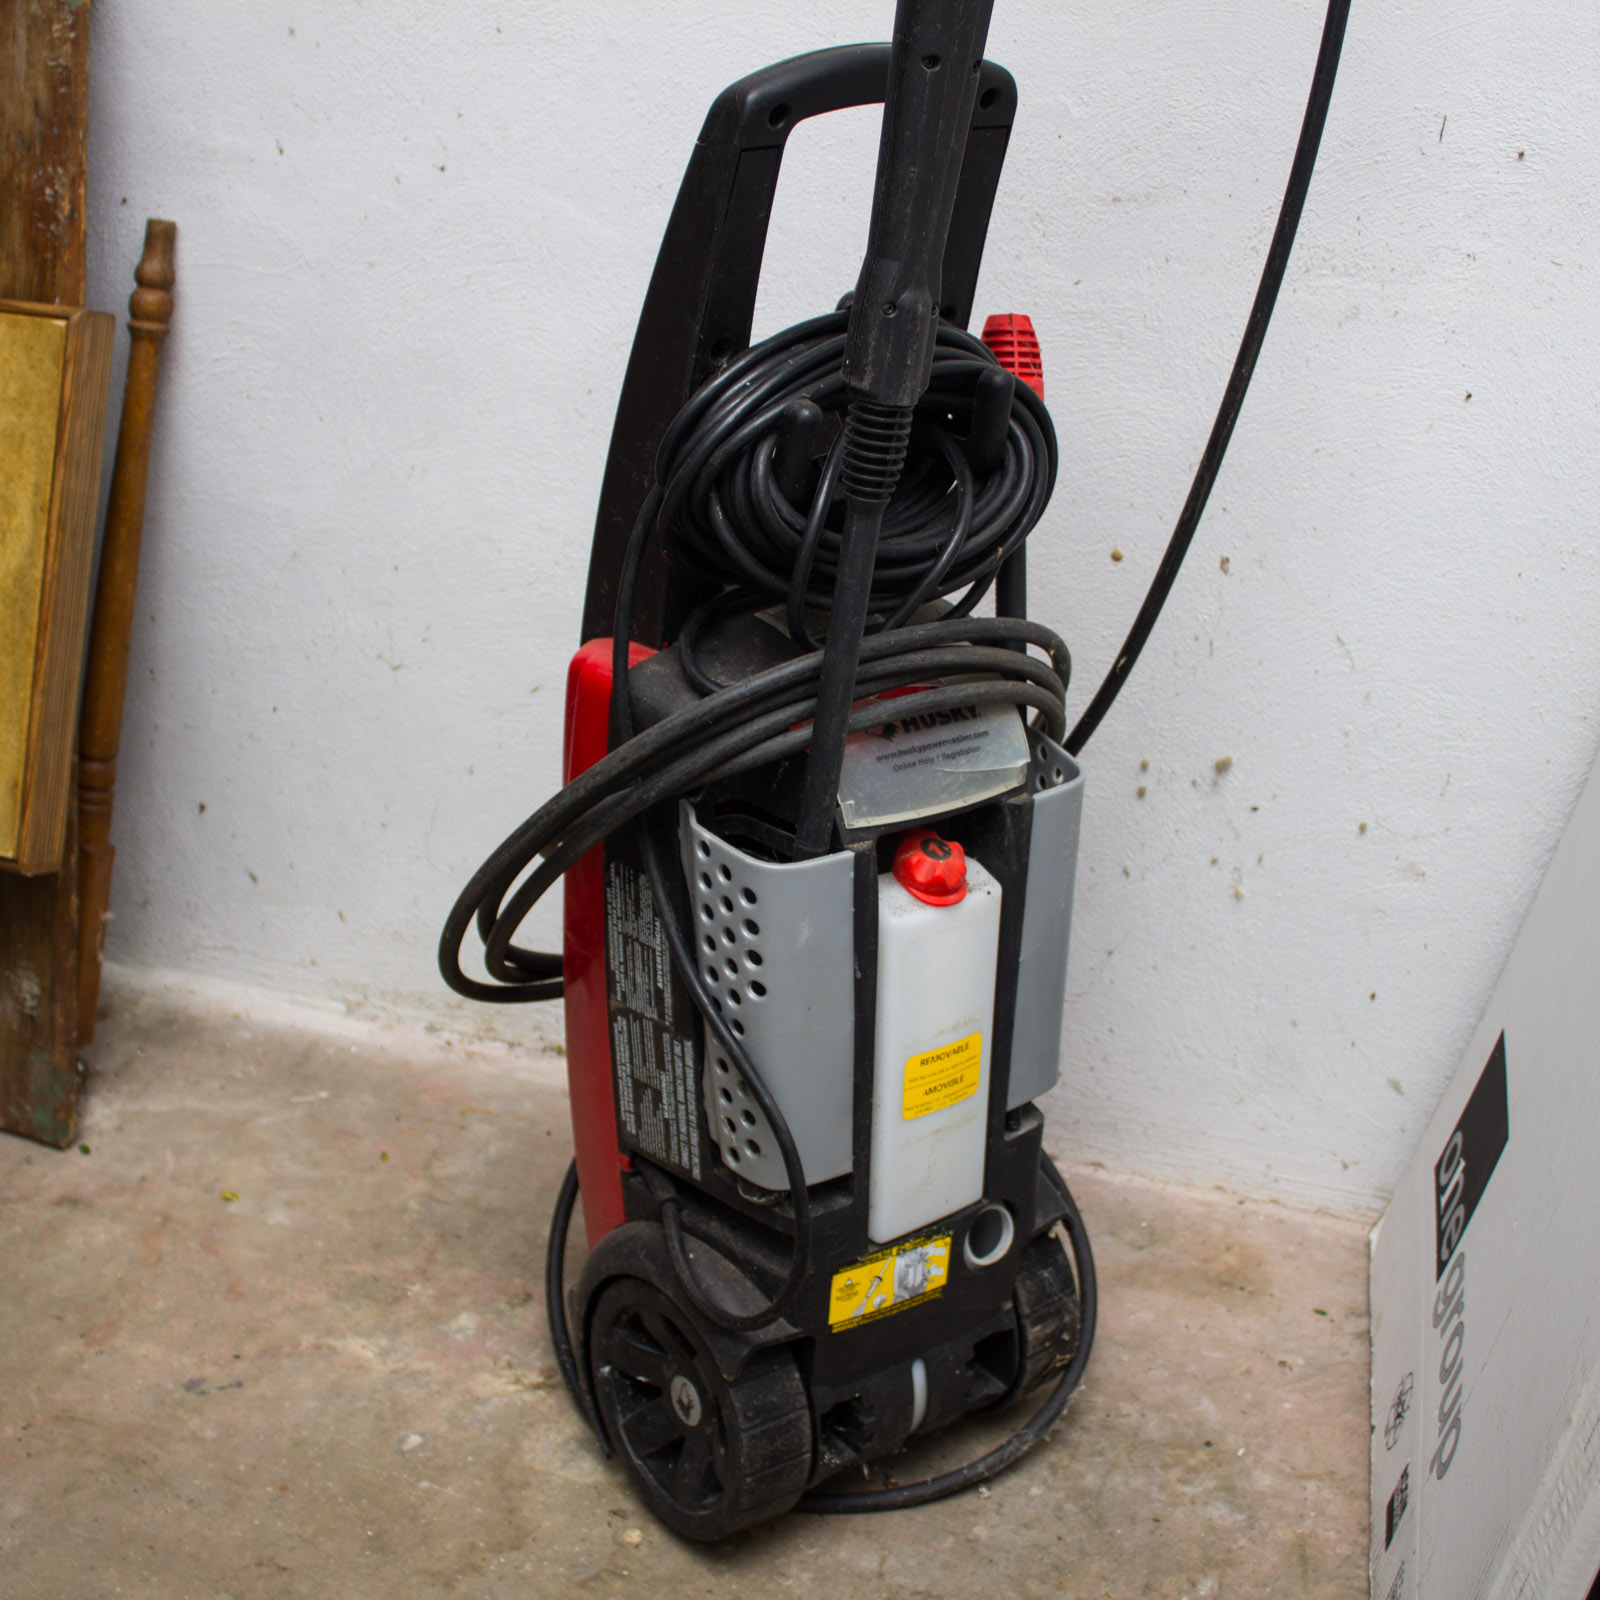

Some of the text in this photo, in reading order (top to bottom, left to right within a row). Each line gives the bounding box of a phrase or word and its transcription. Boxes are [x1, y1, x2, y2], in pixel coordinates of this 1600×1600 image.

[901, 705, 977, 733] HUSKY
[893, 761, 917, 772] Online
[918, 756, 935, 766] Help
[941, 745, 982, 760] Registration
[927, 842, 944, 856] 1
[654, 917, 663, 990] ADVERTENCIA!
[920, 1042, 969, 1067] REMOVABLE
[660, 1071, 669, 1119] WARNING!
[924, 1074, 964, 1097] AMOVIBLE
